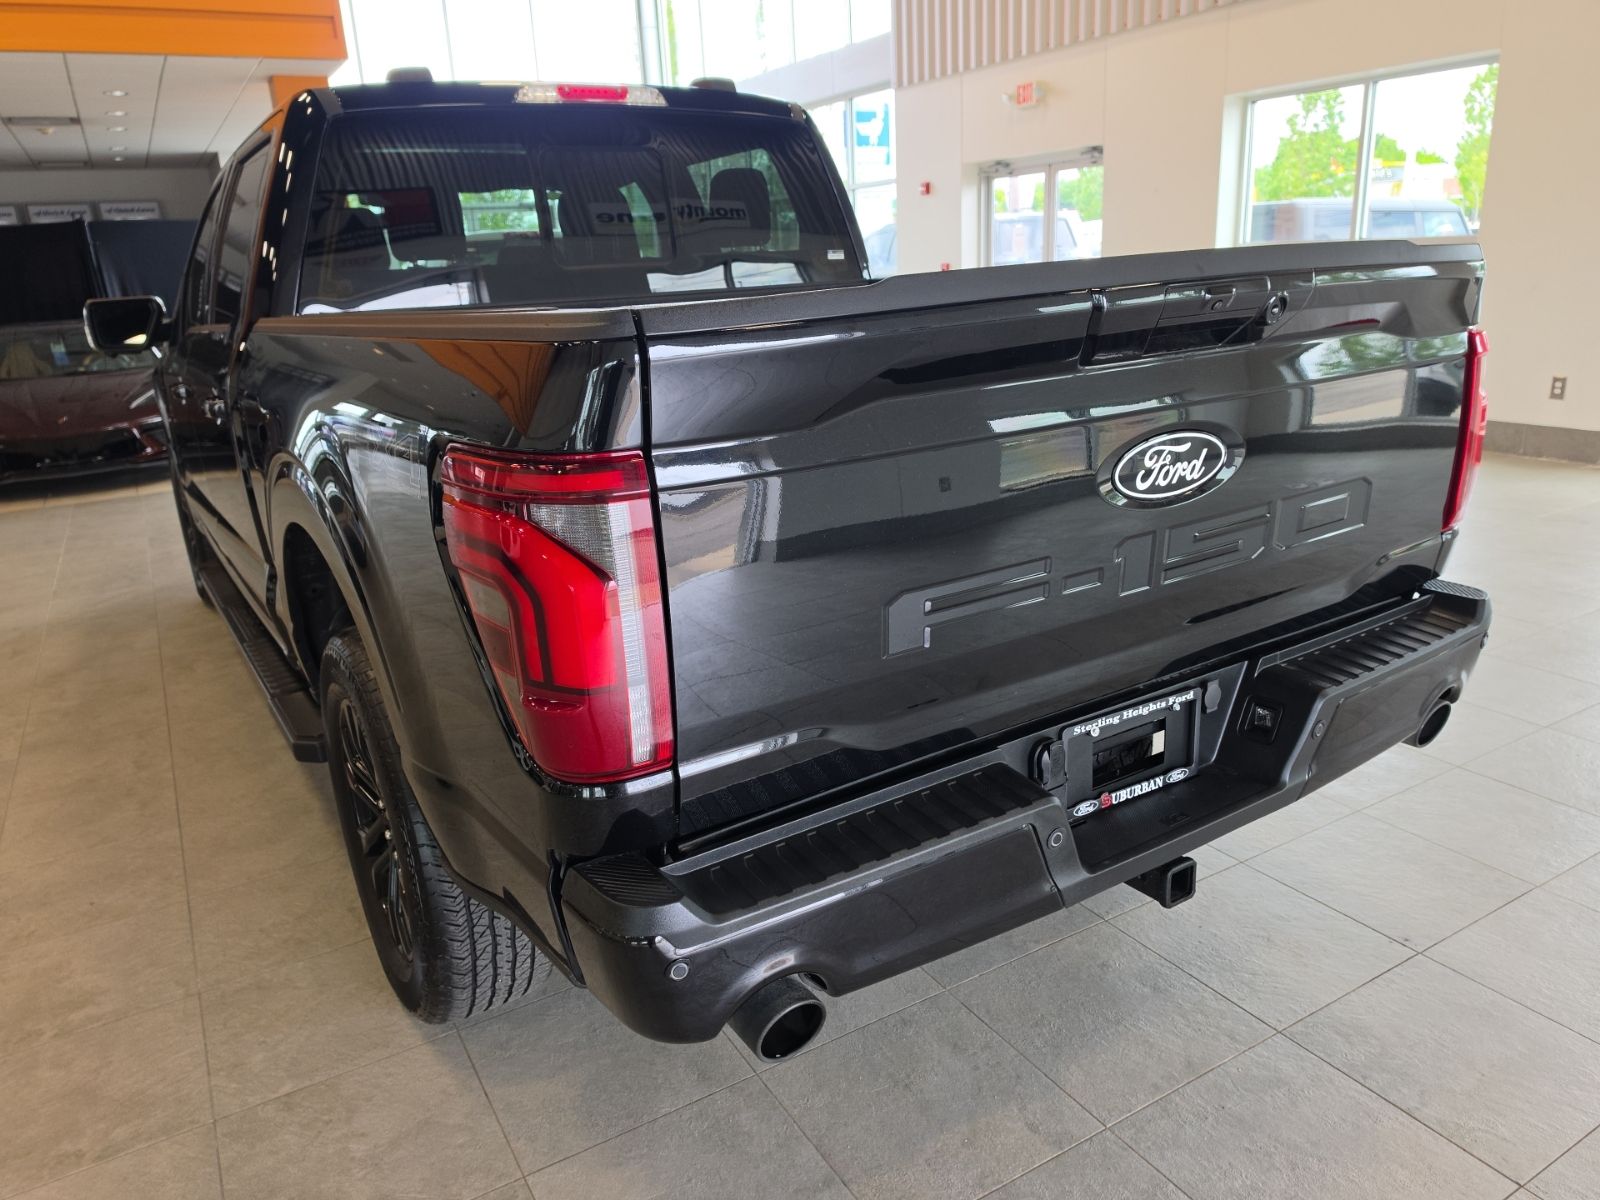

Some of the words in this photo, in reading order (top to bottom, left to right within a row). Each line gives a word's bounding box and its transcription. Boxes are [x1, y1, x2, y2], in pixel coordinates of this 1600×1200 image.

[1135, 441, 1209, 491] Ford
[882, 476, 1372, 660] F-150
[1073, 715, 1121, 736] Sterling
[1122, 701, 1167, 720] Heights
[1167, 690, 1194, 706] Ford
[1100, 775, 1164, 809] SUBURBAN
